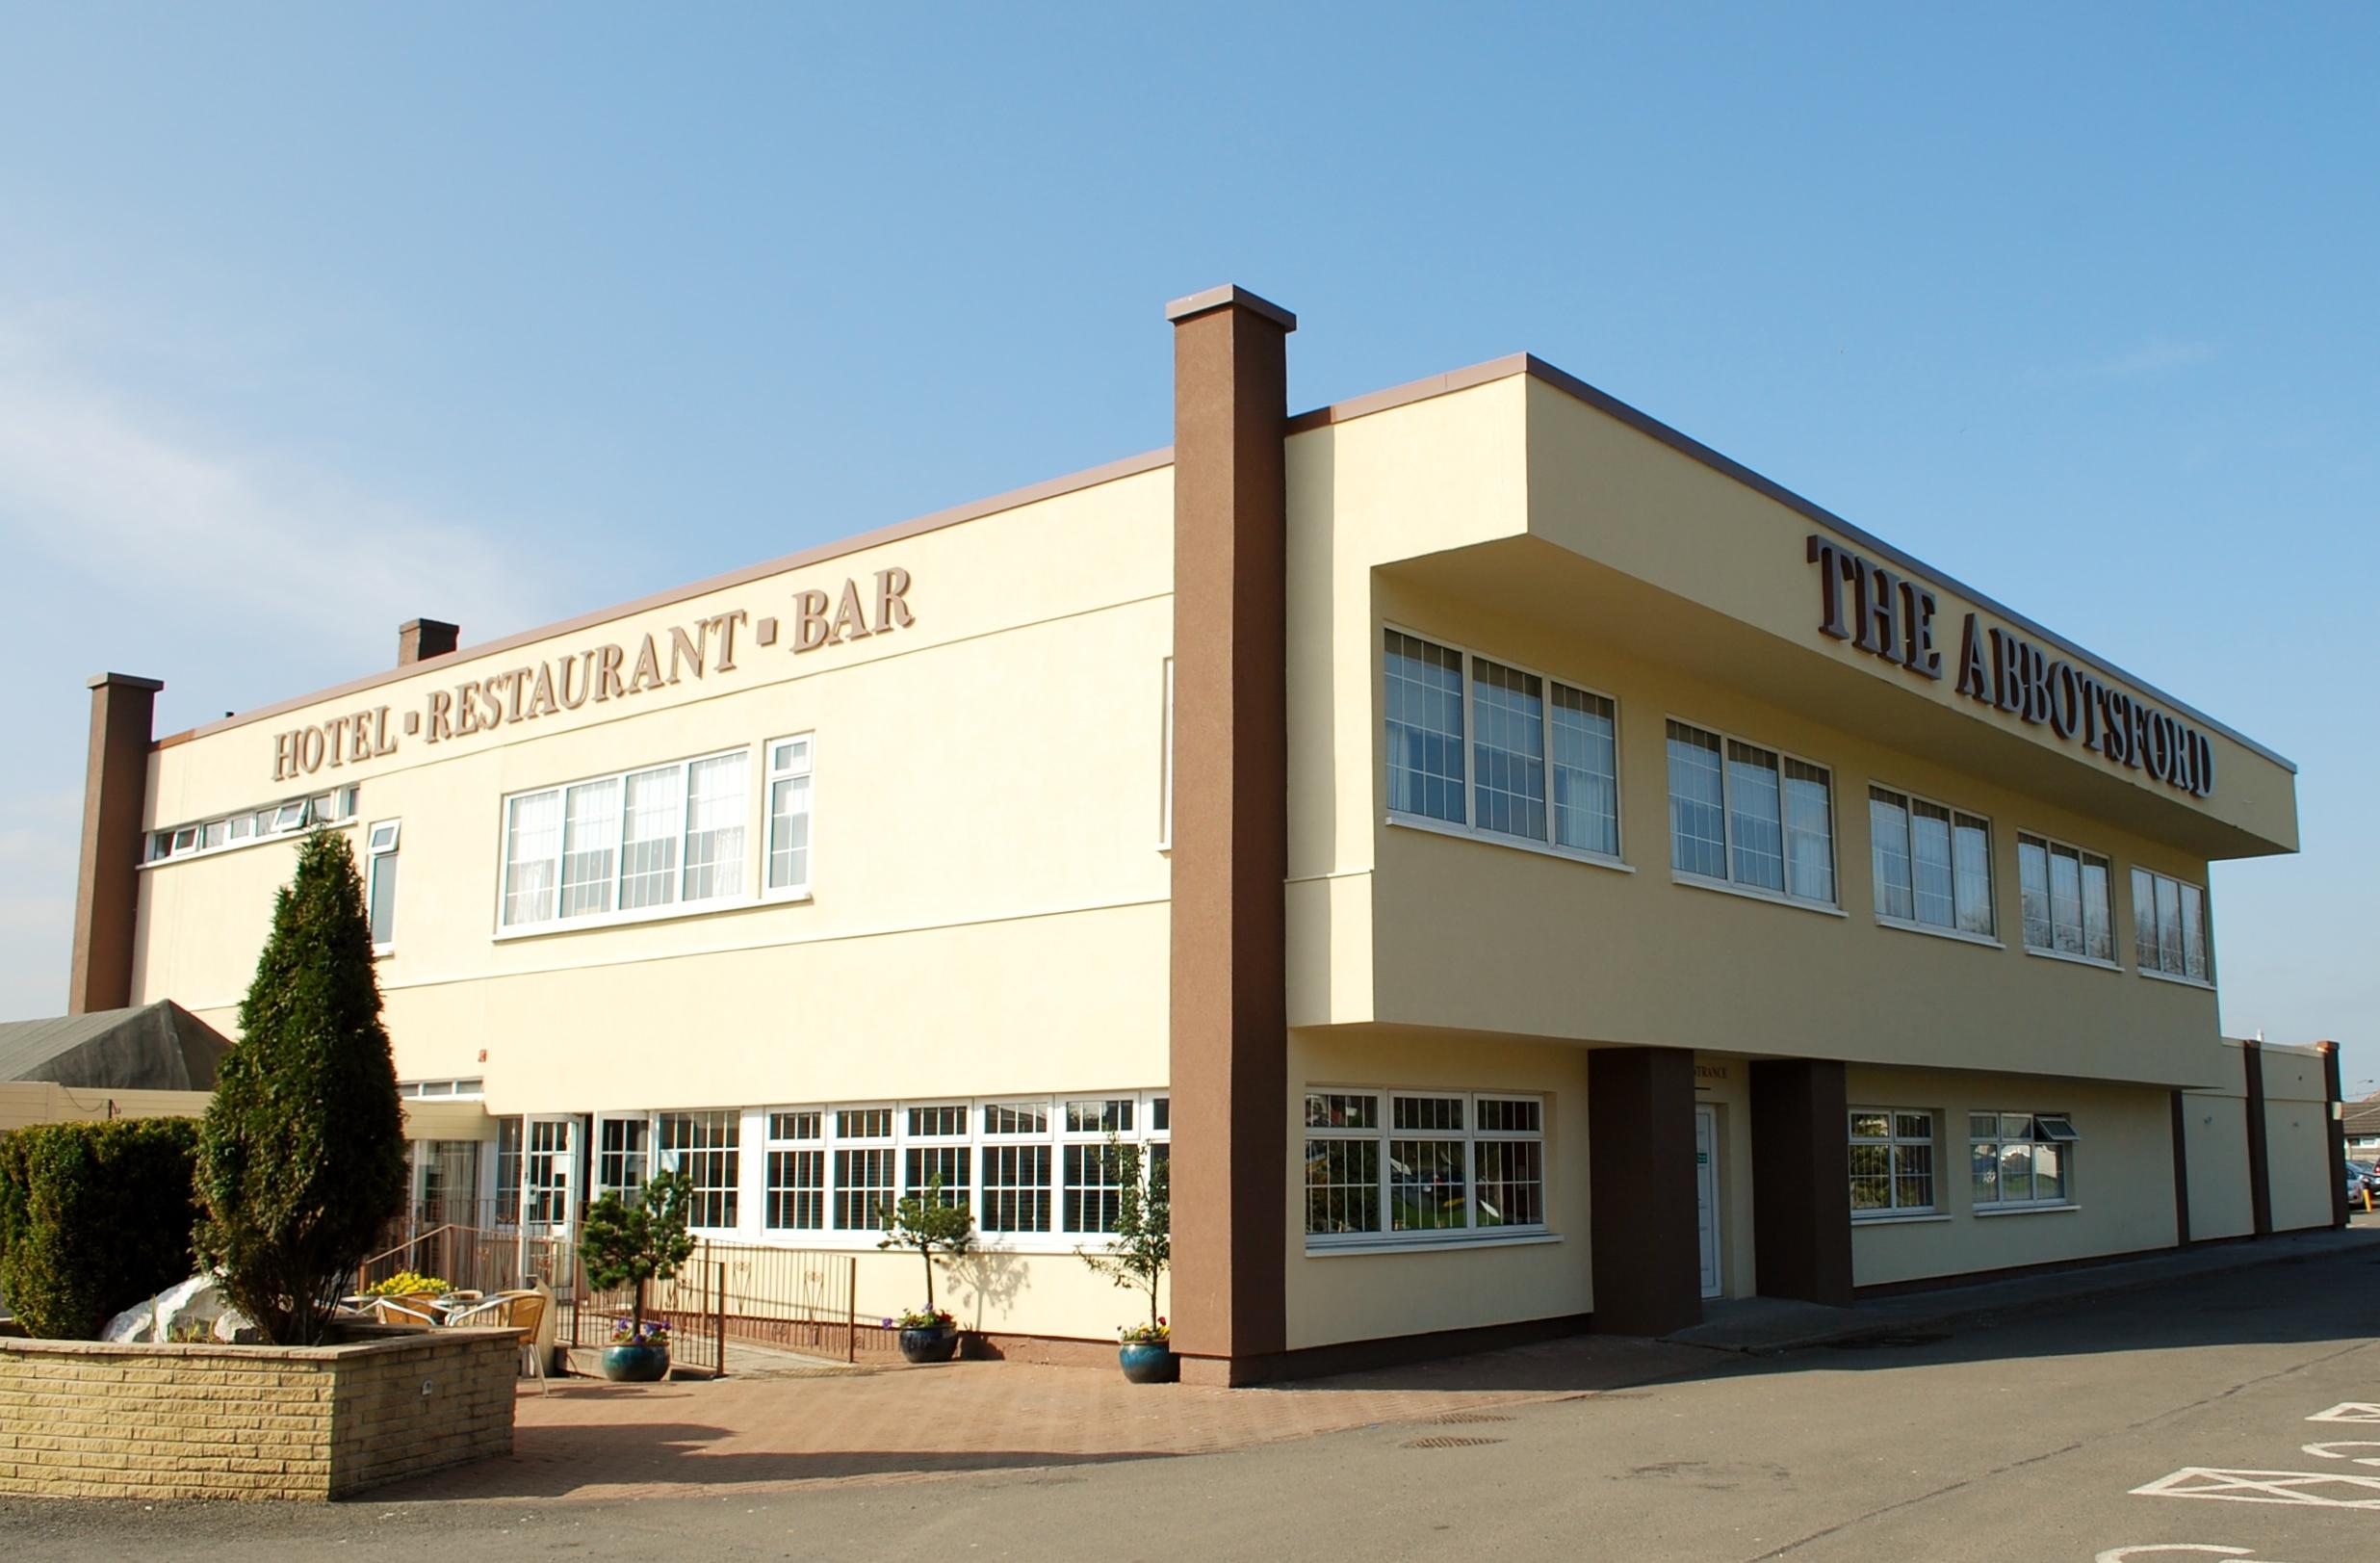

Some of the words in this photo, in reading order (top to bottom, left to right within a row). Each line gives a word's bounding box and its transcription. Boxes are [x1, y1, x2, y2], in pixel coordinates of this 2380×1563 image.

[270, 705, 399, 782] HOTEL
[425, 608, 746, 744] RESTAURANT
[789, 565, 916, 655] BAR
[1806, 534, 1943, 682] THE
[1954, 612, 2215, 799] ABBOTSFORD
[1694, 1065, 1727, 1080] TRANCE
